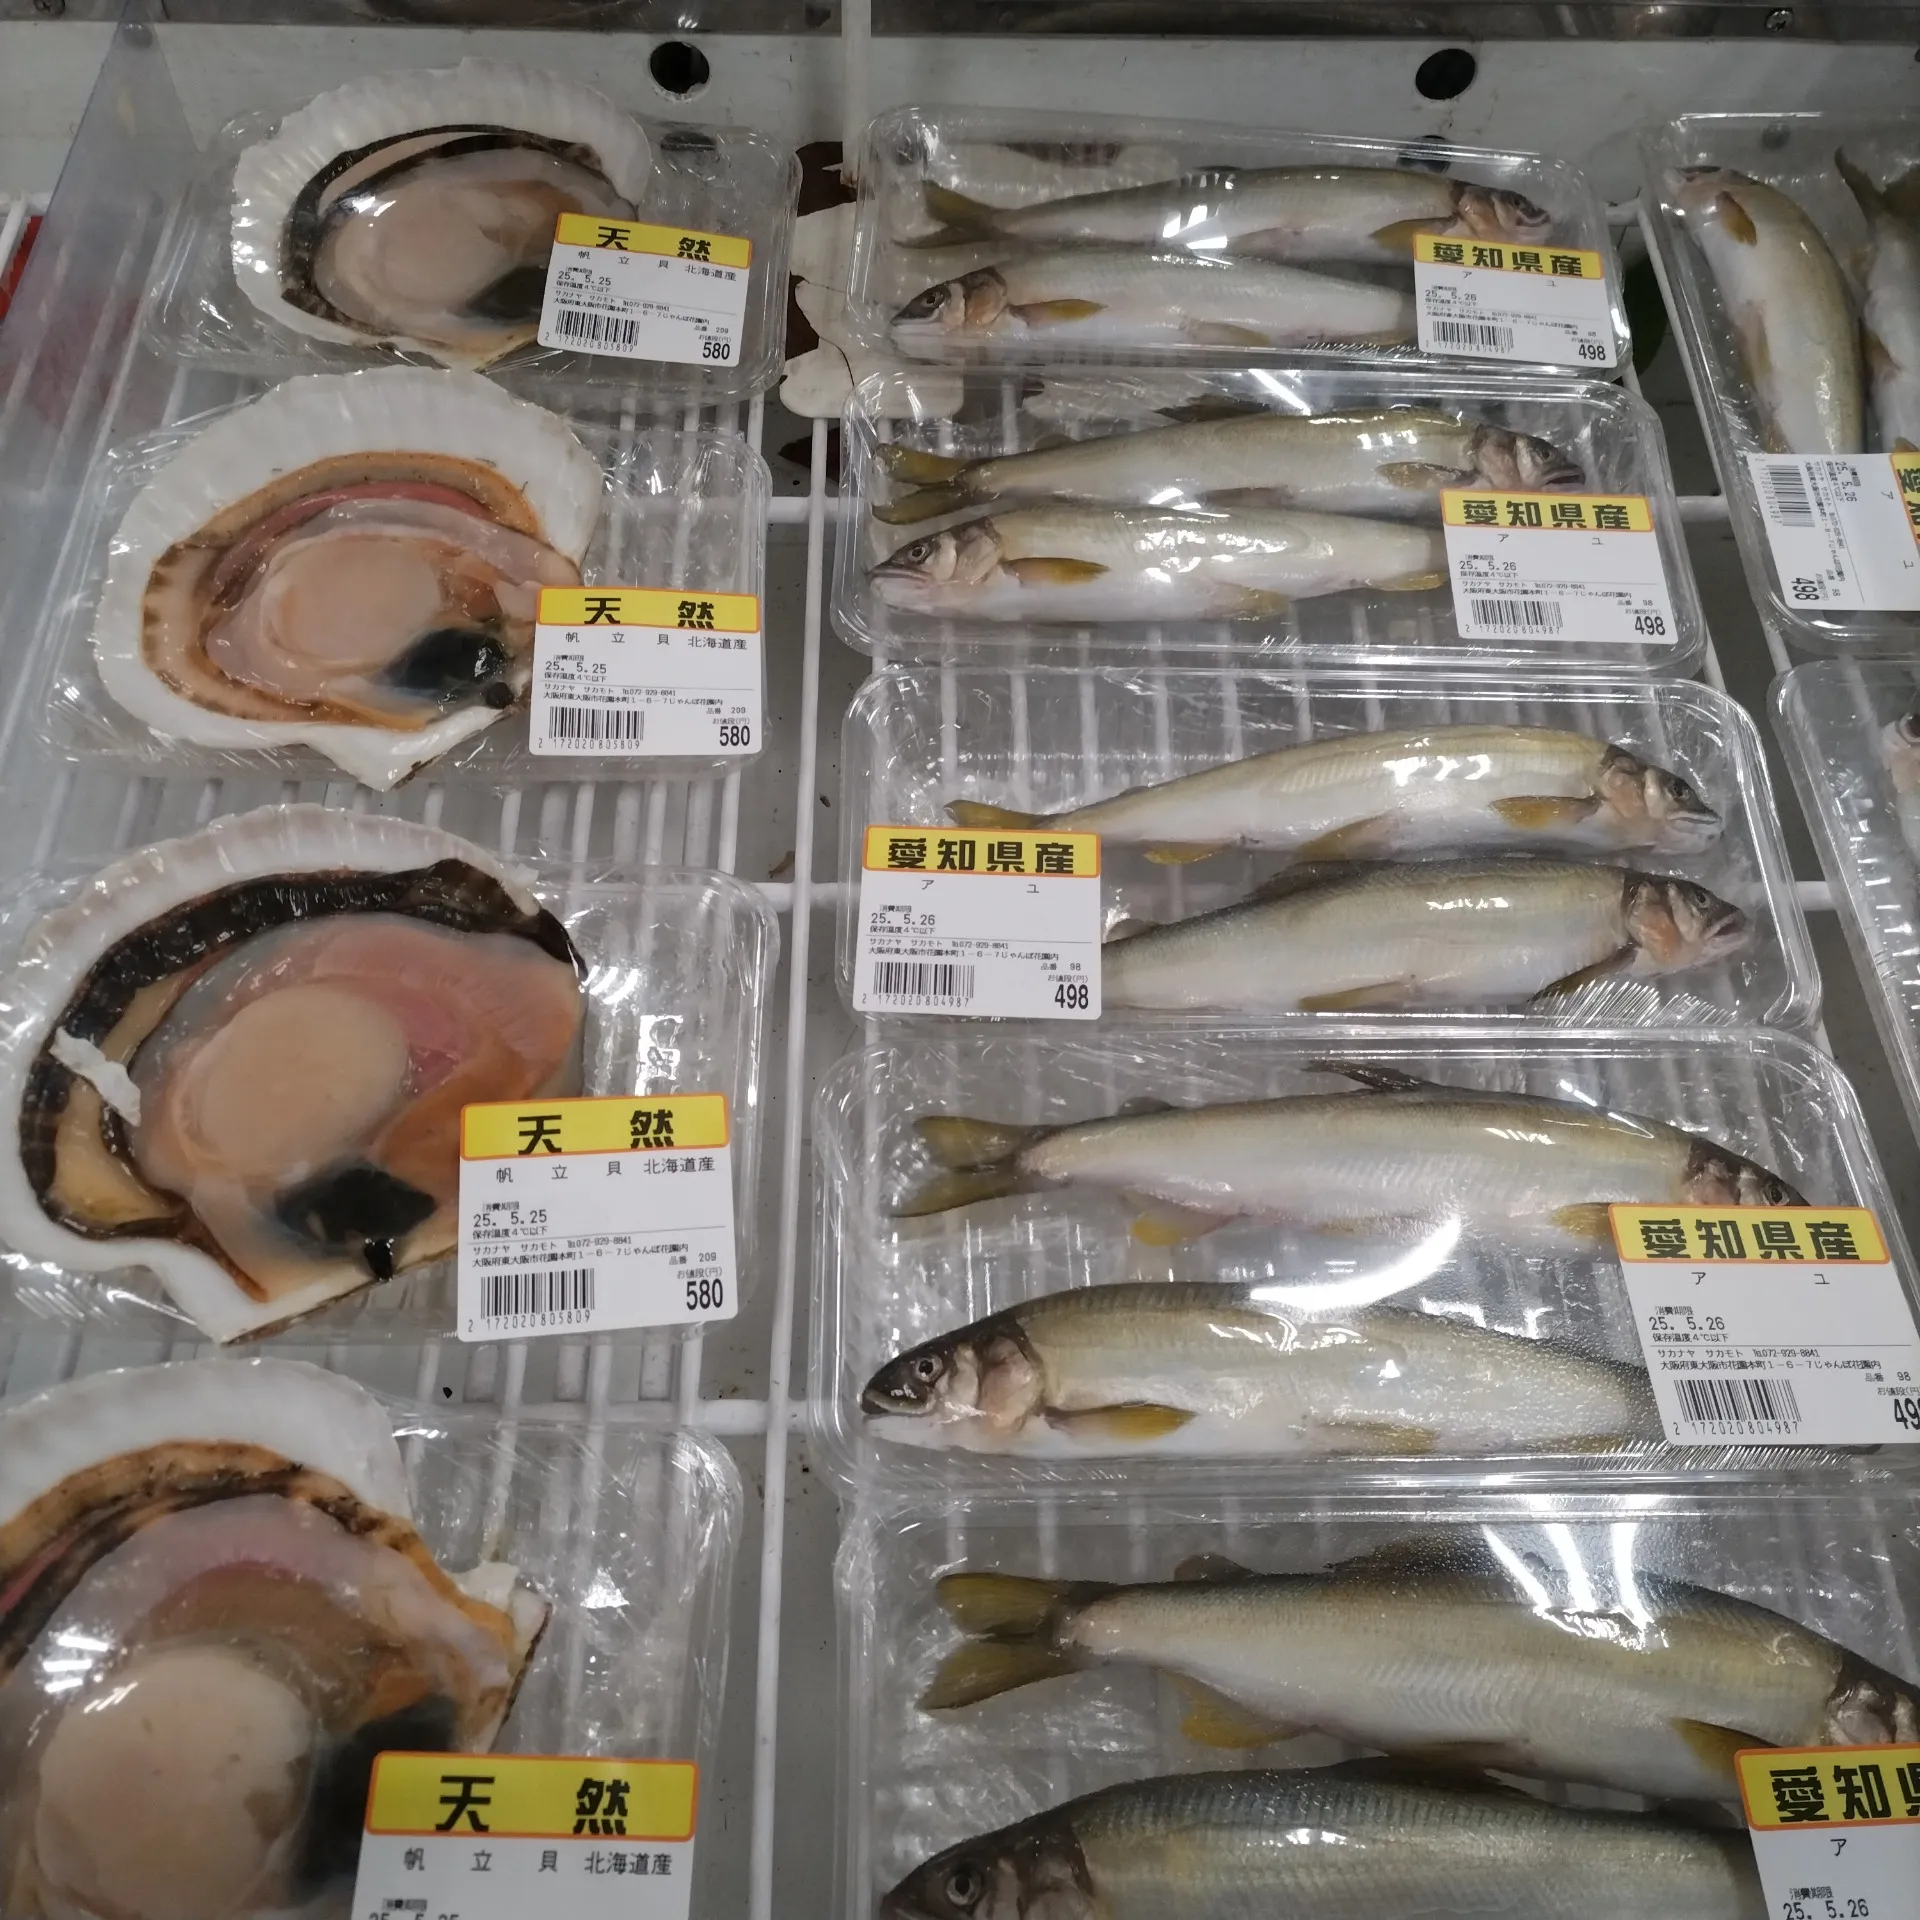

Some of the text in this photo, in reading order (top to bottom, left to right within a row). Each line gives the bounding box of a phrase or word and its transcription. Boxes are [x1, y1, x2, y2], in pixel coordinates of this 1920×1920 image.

[596, 225, 712, 262] 天然
[685, 264, 737, 281] 北海道産
[1433, 242, 1583, 277] 愛知県産
[702, 342, 730, 360] 580
[1578, 344, 1606, 361] 498
[1462, 499, 1630, 530] 愛知県産
[1791, 577, 1820, 601] 498
[584, 597, 714, 629] 天然
[1634, 616, 1666, 636] 498
[688, 636, 748, 650] 北海道産
[719, 726, 750, 746] 580
[887, 837, 1074, 874] 愛知県産
[1054, 984, 1089, 1009] 498
[517, 1108, 674, 1156] 天然
[644, 1156, 715, 1175] 北海道産
[1638, 1218, 1860, 1261] 愛知県産
[686, 1278, 723, 1311] 580
[1892, 1397, 1920, 1431] 49
[435, 1775, 631, 1836] 天然
[1830, 1838, 1847, 1856] ア
[584, 1850, 672, 1876] 北海道産
